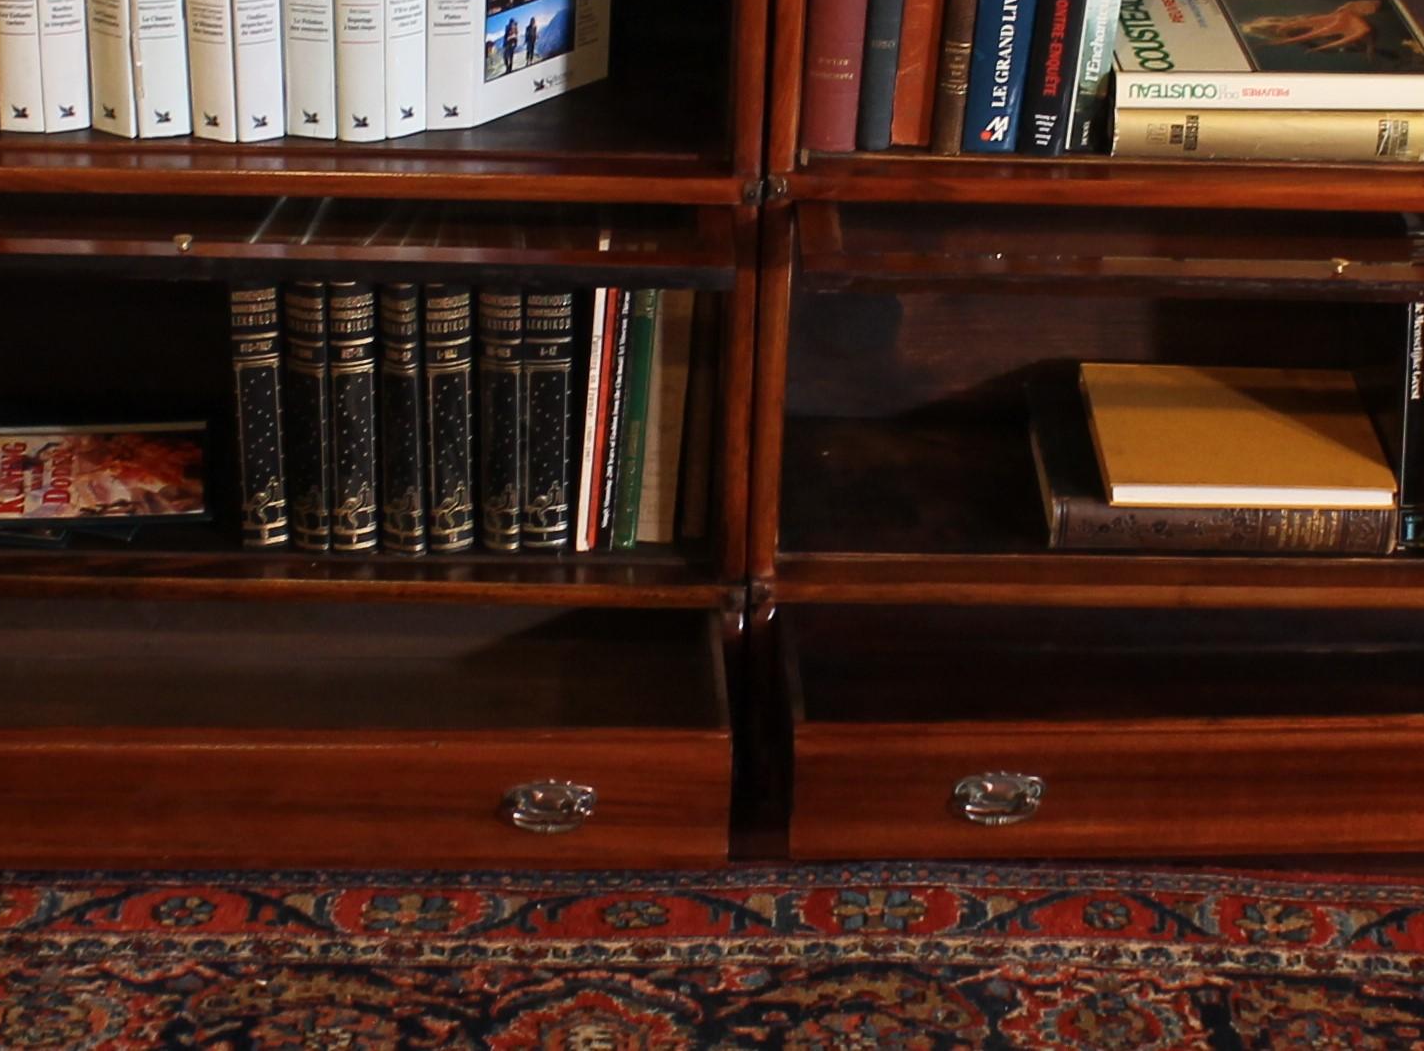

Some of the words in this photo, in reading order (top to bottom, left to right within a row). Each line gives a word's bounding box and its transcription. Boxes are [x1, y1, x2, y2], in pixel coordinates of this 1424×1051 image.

[994, 24, 1016, 84] GRAND
[991, 85, 1008, 109] LE
[1128, 83, 1218, 99] COUSTEAU
